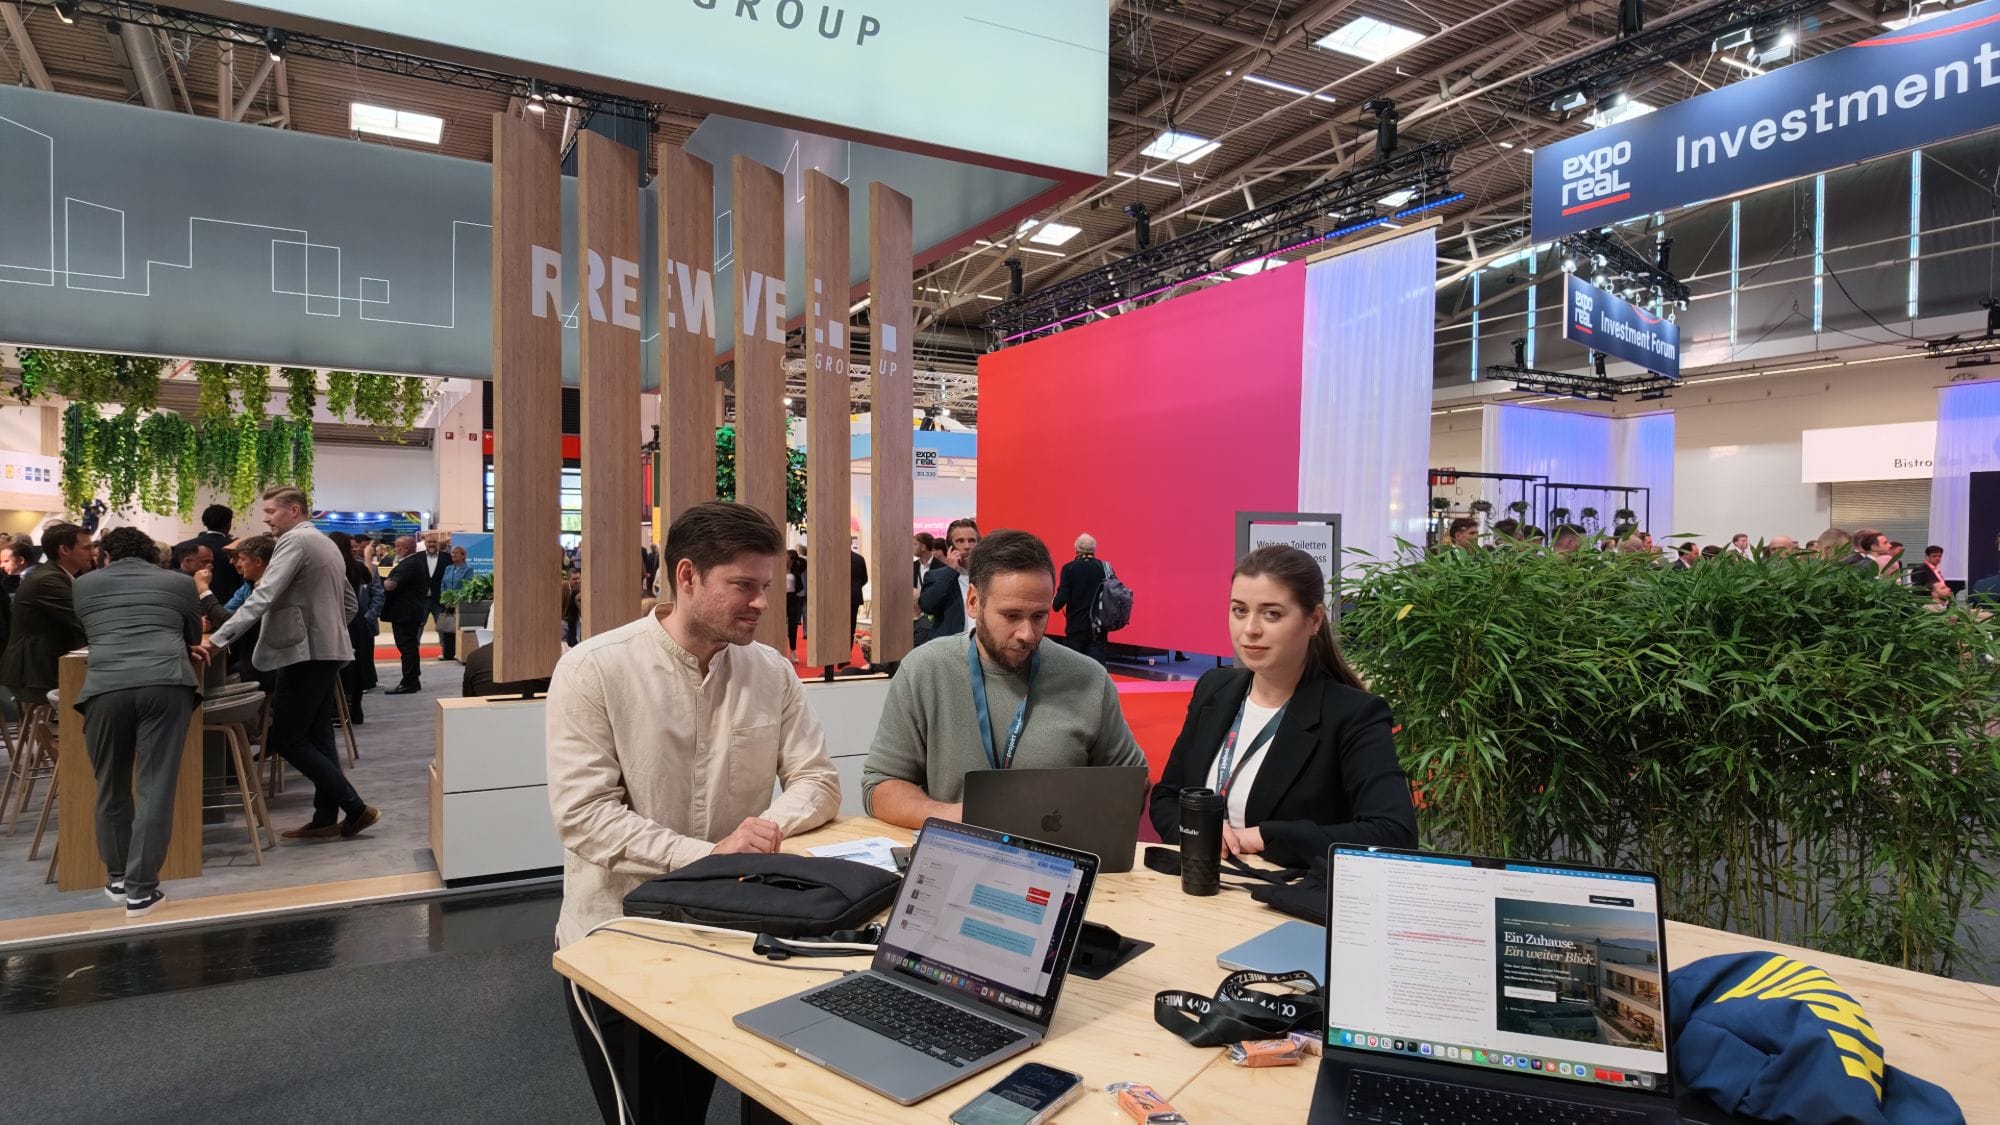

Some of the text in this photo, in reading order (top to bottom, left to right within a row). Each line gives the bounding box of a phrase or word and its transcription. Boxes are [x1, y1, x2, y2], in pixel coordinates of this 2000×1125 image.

[1676, 42, 2000, 173] Investment
[1562, 140, 1632, 181] expo
[1575, 291, 1594, 312] expo
[1600, 311, 1676, 361] Investment Forum
[915, 451, 937, 459] expo
[1894, 458, 1933, 469] Bistro
[1290, 540, 1327, 550] Toiletten
[1503, 931, 1577, 950] Ein Zuhause.
[1503, 945, 1597, 966] Ein weiter Blick.
